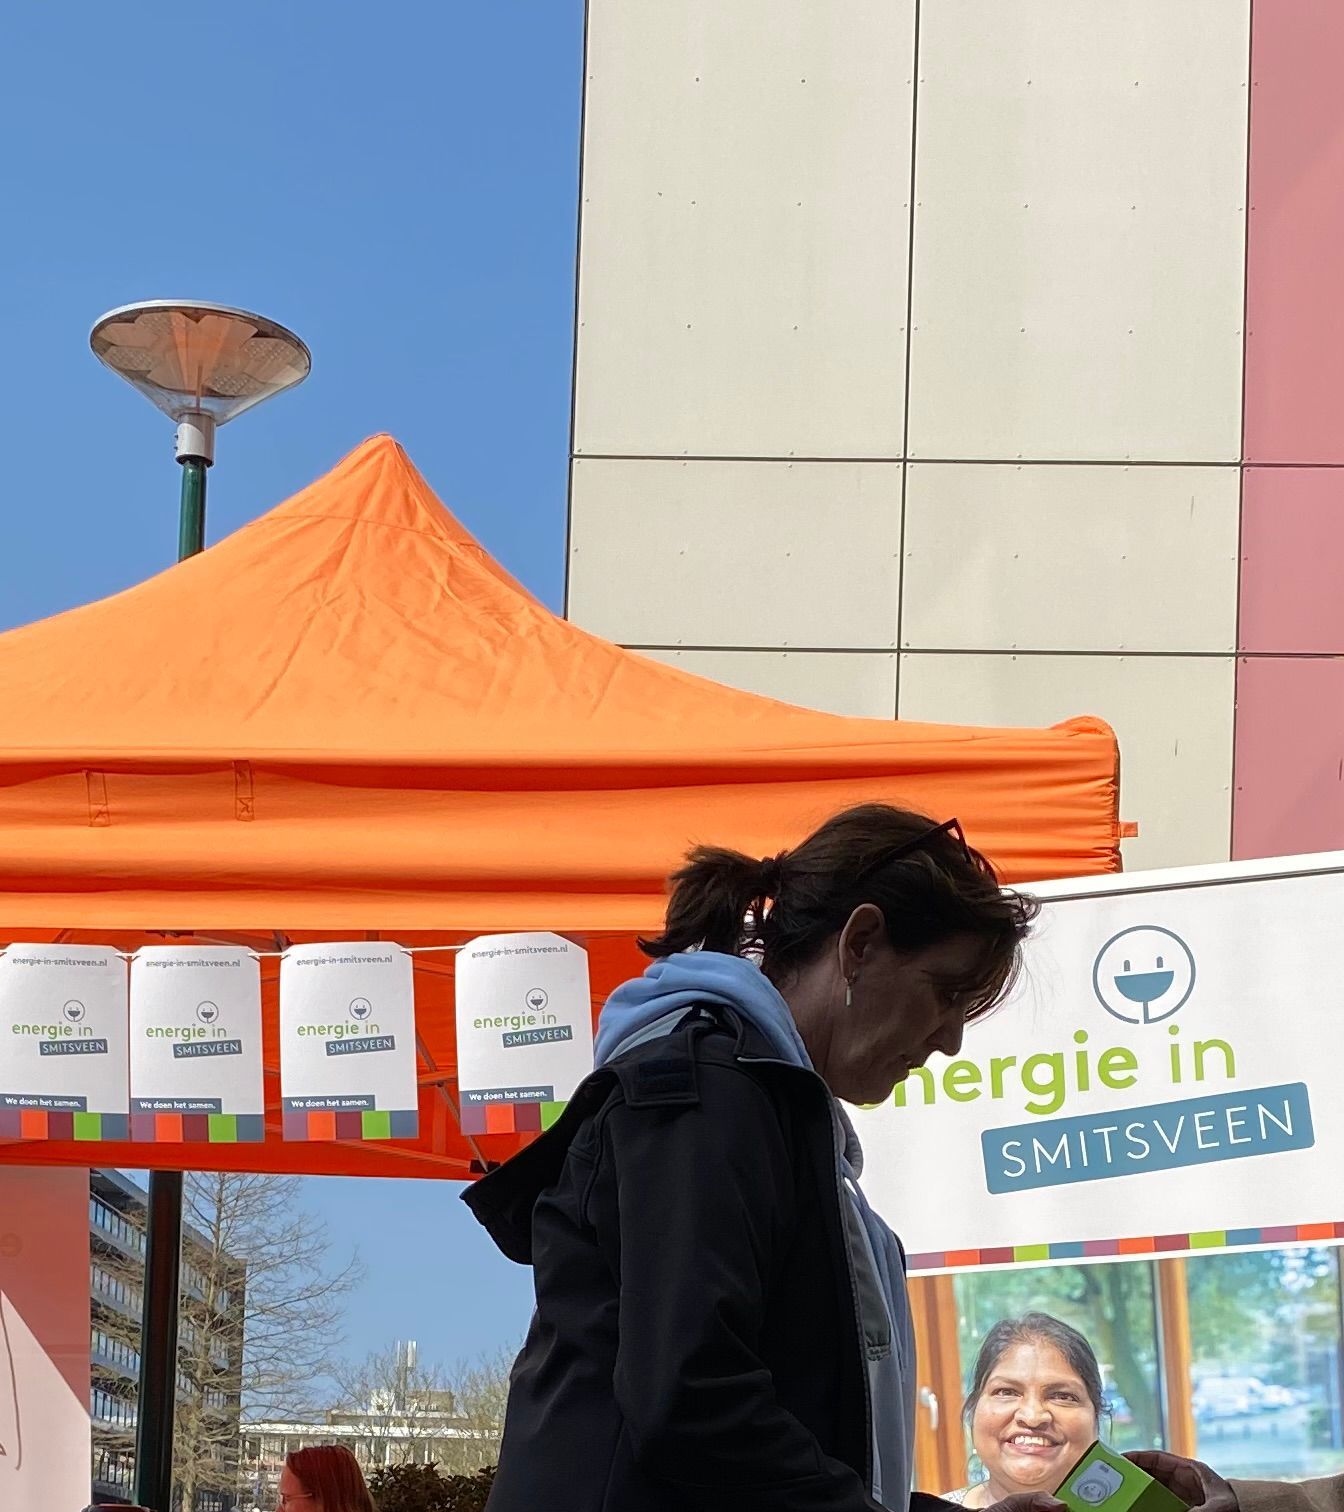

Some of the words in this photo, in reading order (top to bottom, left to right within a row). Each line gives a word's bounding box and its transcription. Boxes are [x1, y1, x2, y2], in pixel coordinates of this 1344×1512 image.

[471, 944, 569, 958] energie-in-smitsveen.nl
[12, 957, 108, 967] energie-in-smitsveen.nl
[146, 959, 241, 968] energie-in-smitsveen.nl
[296, 955, 393, 967] energie-in-smitsveen.nl
[473, 1011, 536, 1030] energie
[541, 1011, 557, 1025] in
[12, 1022, 73, 1039] energie
[78, 1023, 93, 1037] in
[146, 1023, 207, 1041] energie
[212, 1023, 227, 1037] in
[297, 1020, 359, 1038] energie
[365, 1020, 380, 1034] in
[505, 1028, 570, 1046] SMITSVEEN
[42, 1041, 105, 1054] SMITSVEEN
[176, 1042, 239, 1056] SMITSVEEN
[329, 1038, 392, 1054] SMITSVEEN
[859, 1029, 1139, 1115] nergie
[1168, 1024, 1237, 1084] in
[5, 1097, 18, 1105] We
[19, 1097, 37, 1105] doen
[39, 1098, 52, 1106] het
[483, 1092, 503, 1100] doen
[504, 1091, 518, 1099] het
[140, 1101, 153, 1109] We
[154, 1101, 172, 1109] doen
[174, 1101, 187, 1109] het
[291, 1100, 304, 1108] We
[306, 1100, 324, 1108] doen
[326, 1099, 339, 1107] het
[1001, 1098, 1294, 1179] SMITSVEEN
